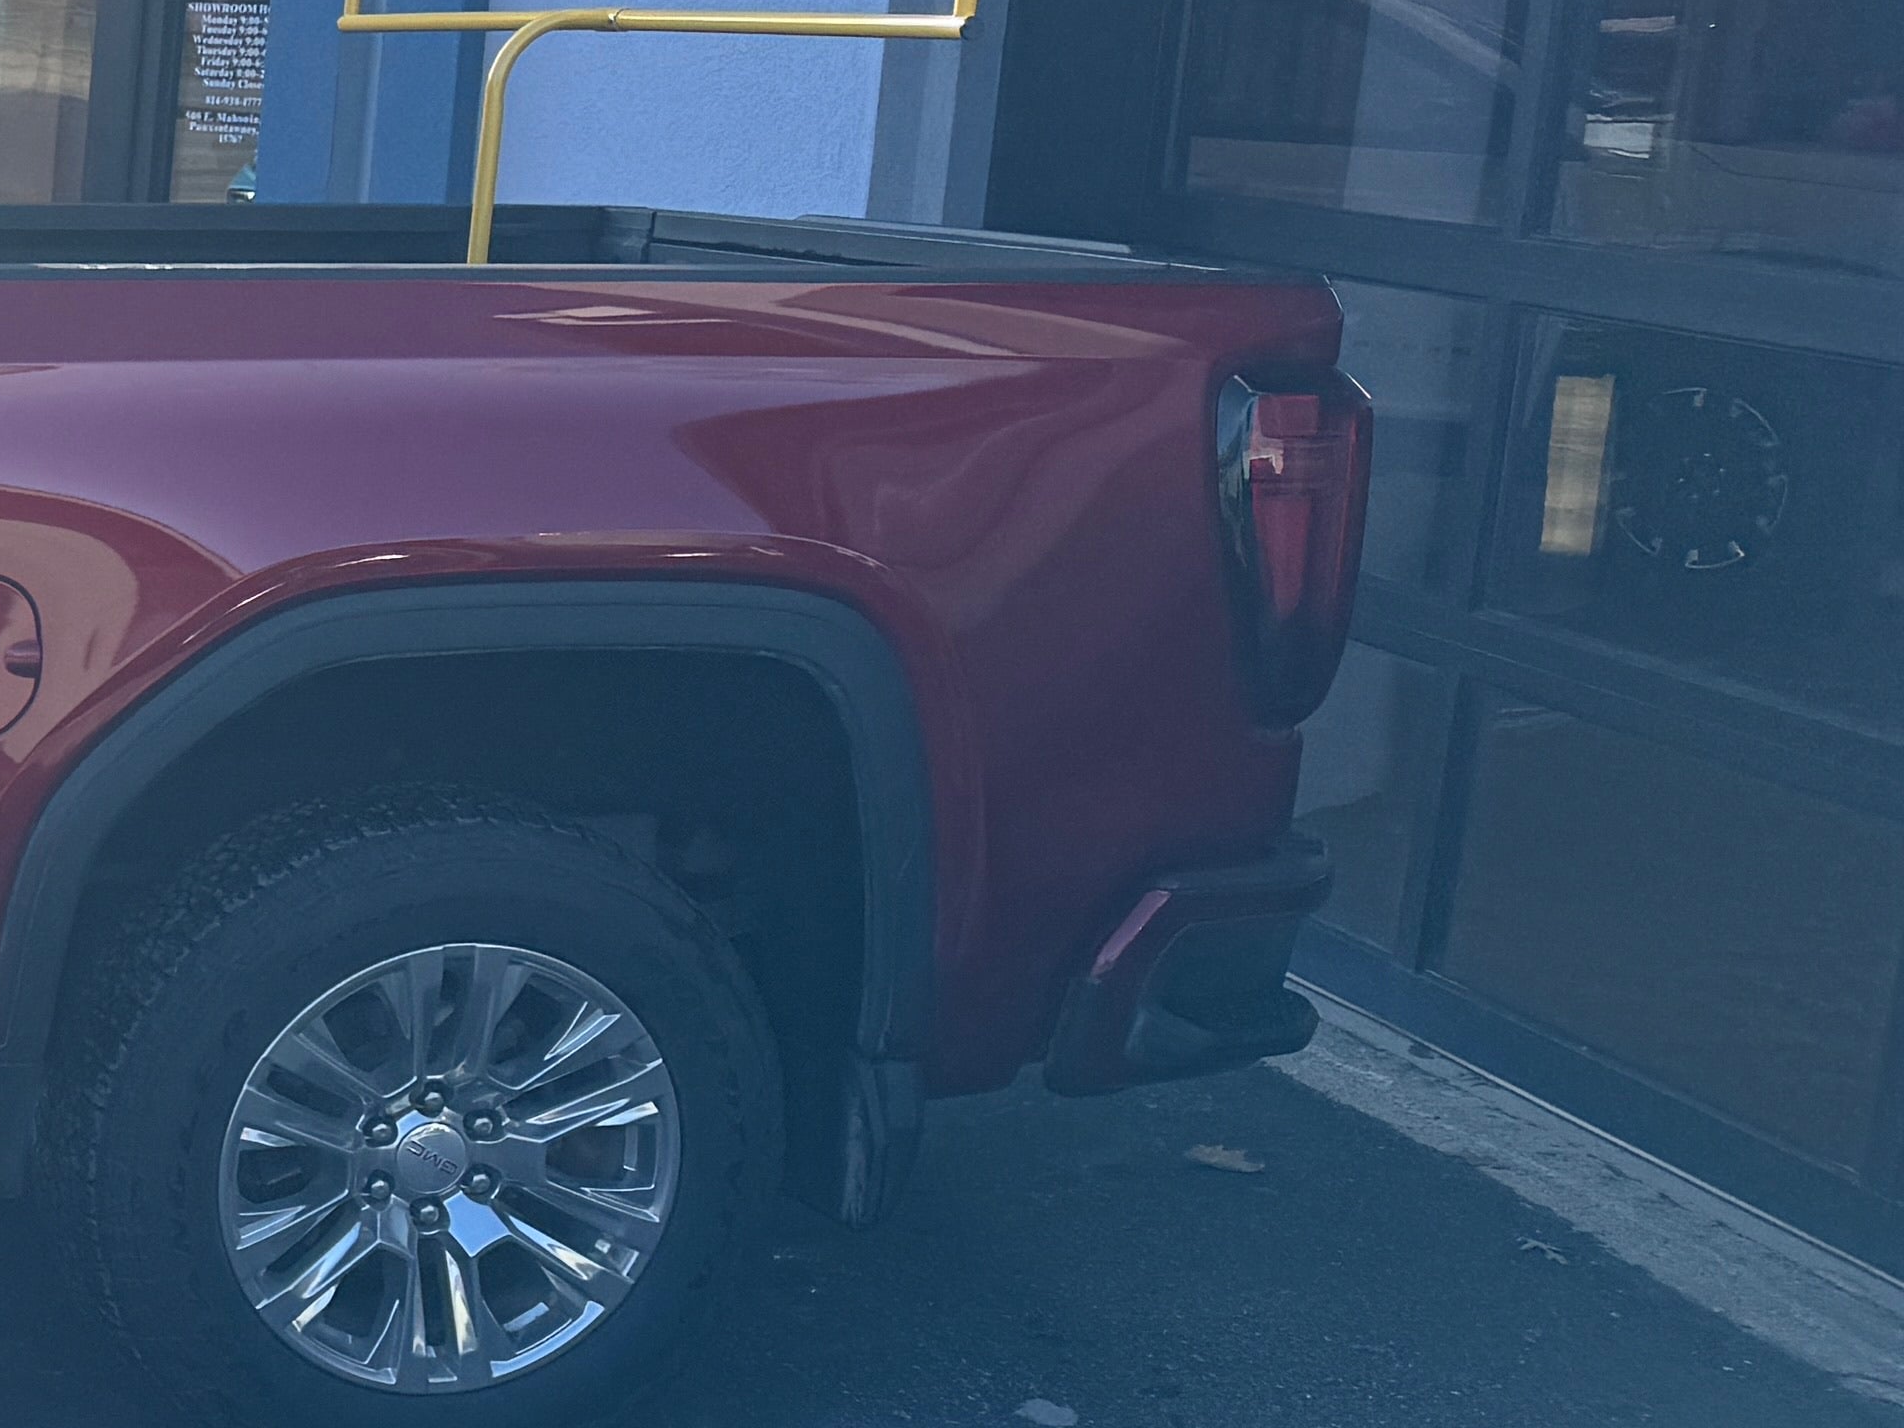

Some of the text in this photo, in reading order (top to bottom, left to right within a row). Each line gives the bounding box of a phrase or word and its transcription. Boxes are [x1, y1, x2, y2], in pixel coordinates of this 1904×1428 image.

[188, 2, 257, 14] SHOWROOM
[195, 67, 234, 80] Saturday
[203, 78, 236, 90] Sunday
[406, 1138, 458, 1175] GMC
